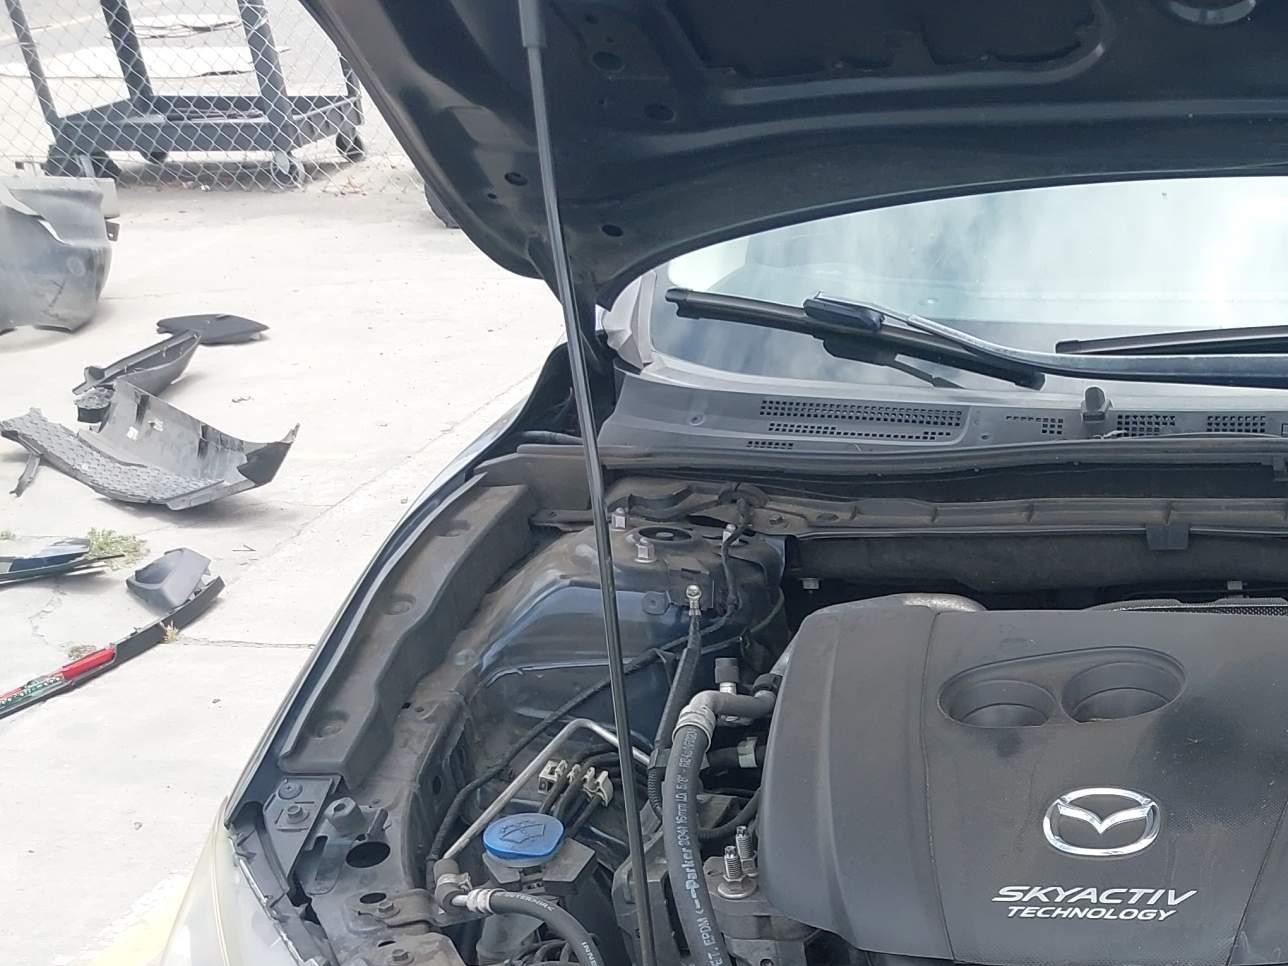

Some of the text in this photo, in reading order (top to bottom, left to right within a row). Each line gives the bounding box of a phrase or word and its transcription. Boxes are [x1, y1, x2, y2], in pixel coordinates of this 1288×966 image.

[682, 847, 700, 890] Parker
[992, 885, 1198, 906] SKYACTIV
[1007, 906, 1177, 921] TECHNOLOGY
